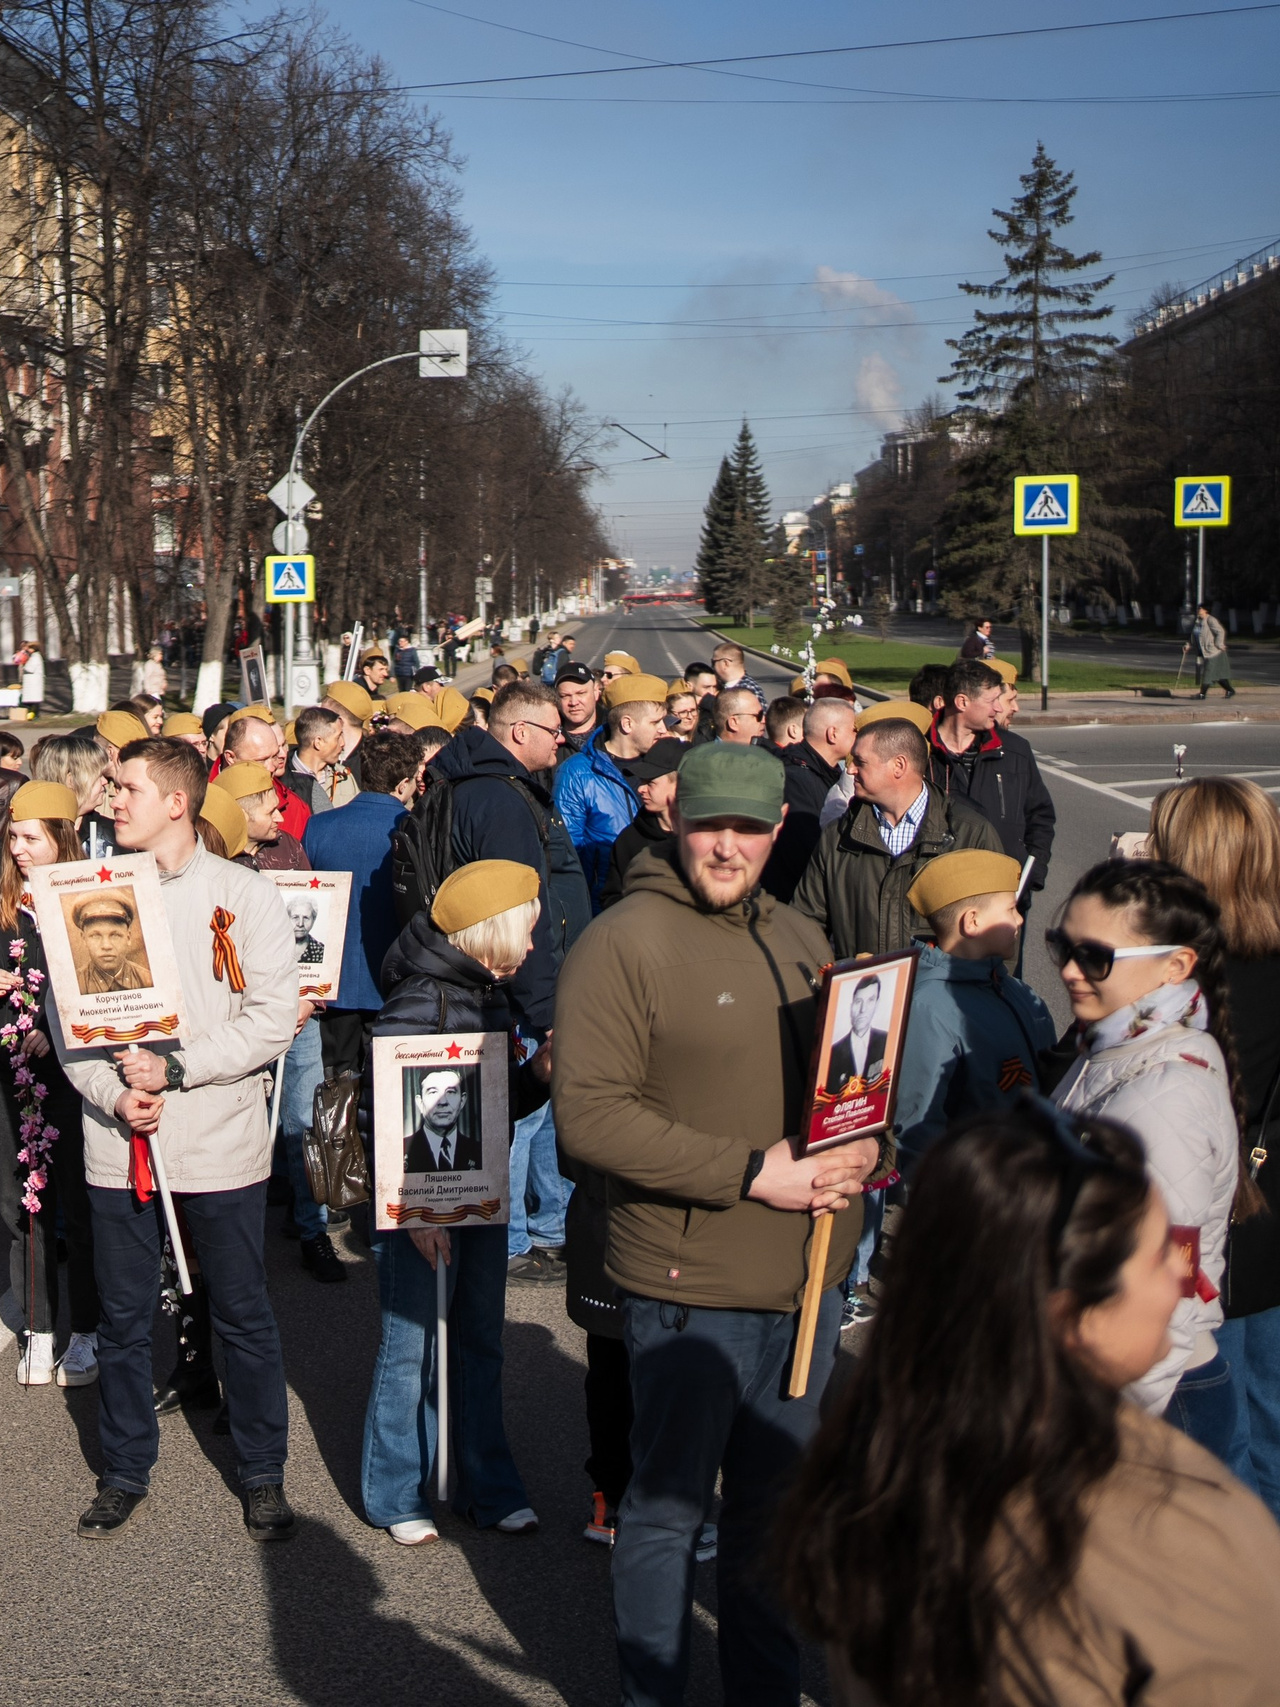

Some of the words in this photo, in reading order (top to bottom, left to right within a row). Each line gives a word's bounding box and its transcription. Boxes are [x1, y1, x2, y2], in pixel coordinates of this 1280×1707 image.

[95, 992, 142, 1004] Корчуганов
[79, 1005, 122, 1017] Инокентий
[123, 1001, 164, 1012] Иванович
[833, 1096, 868, 1114] ФЛЯГИН
[424, 1174, 462, 1183] Ляшенко
[398, 1186, 434, 1196] Василий
[436, 1185, 489, 1196] Дмитриевич
